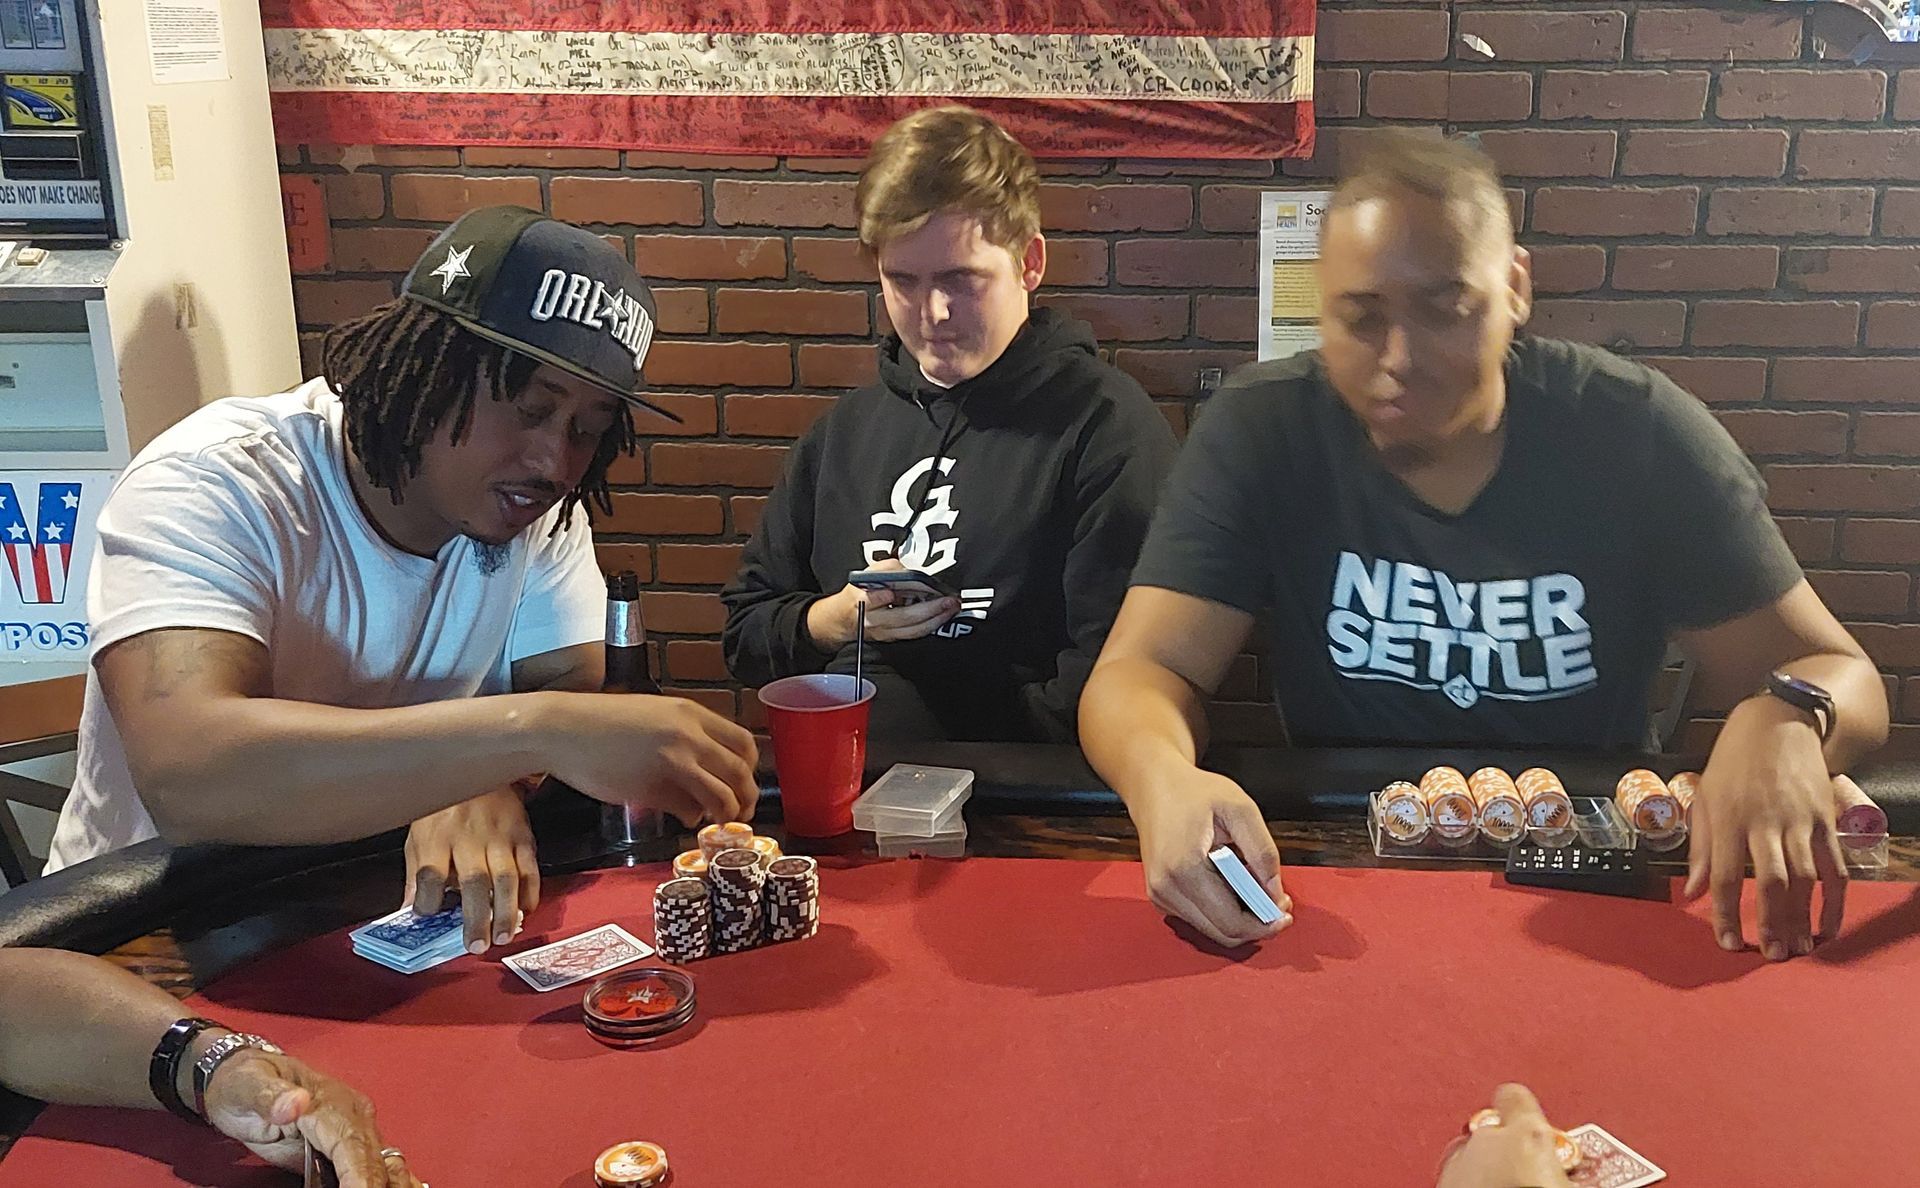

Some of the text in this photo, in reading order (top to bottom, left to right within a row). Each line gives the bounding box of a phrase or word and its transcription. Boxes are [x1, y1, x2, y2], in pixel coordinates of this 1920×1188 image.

[17, 186, 37, 204] NOT
[40, 186, 65, 204] MAKE
[67, 186, 101, 204] CHANG
[1332, 550, 1591, 640] NEVER
[0, 622, 92, 650] POS
[1326, 609, 1599, 691] SETTLE
